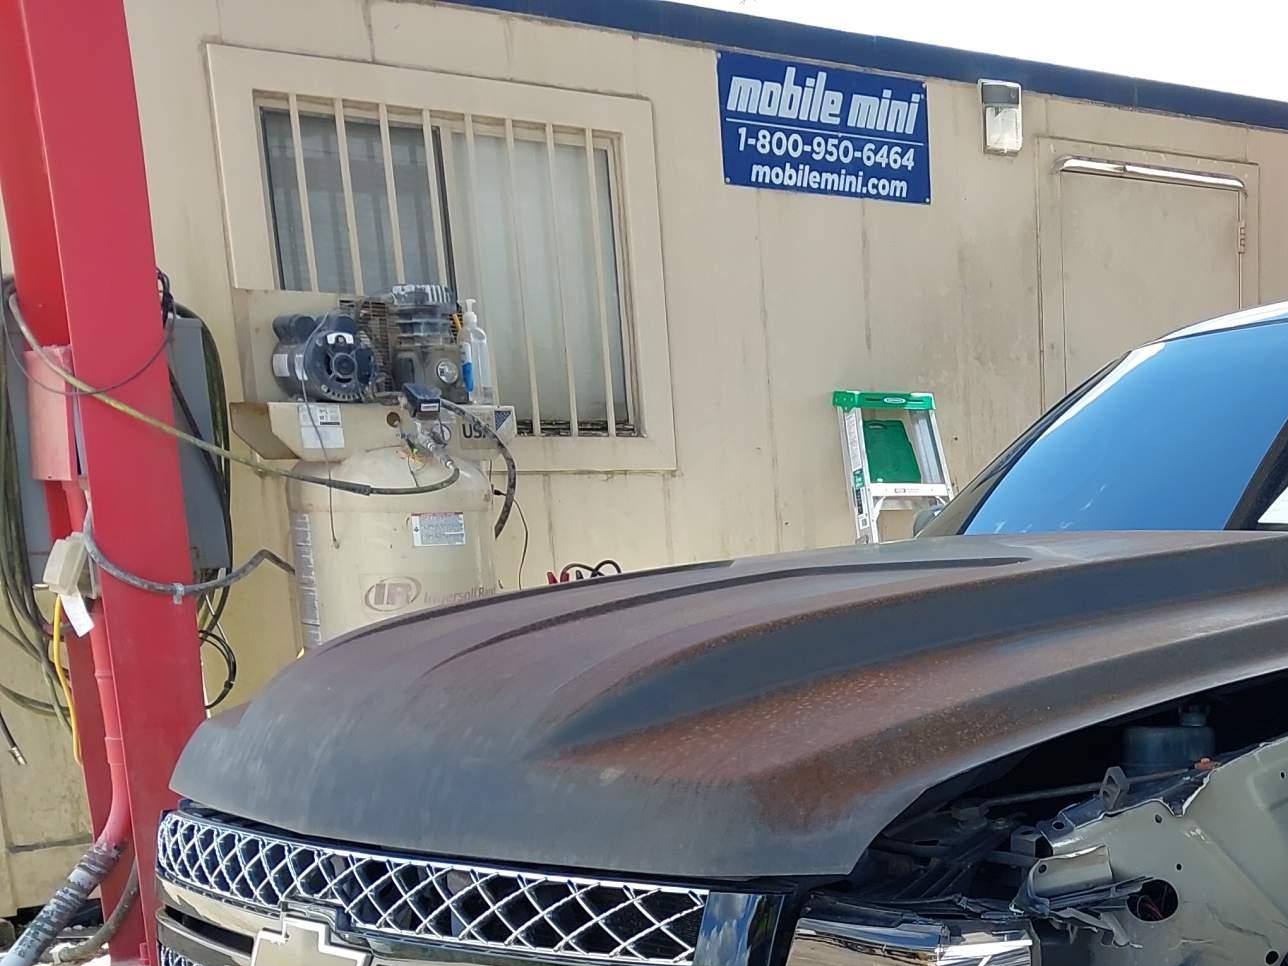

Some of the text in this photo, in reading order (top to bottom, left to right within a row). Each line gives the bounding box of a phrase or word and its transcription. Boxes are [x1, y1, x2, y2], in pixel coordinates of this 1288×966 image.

[726, 66, 921, 135] mobile mini
[738, 127, 915, 171] 1-800-950-6464
[751, 163, 908, 197] mobilemini.com
[462, 423, 487, 439] US
